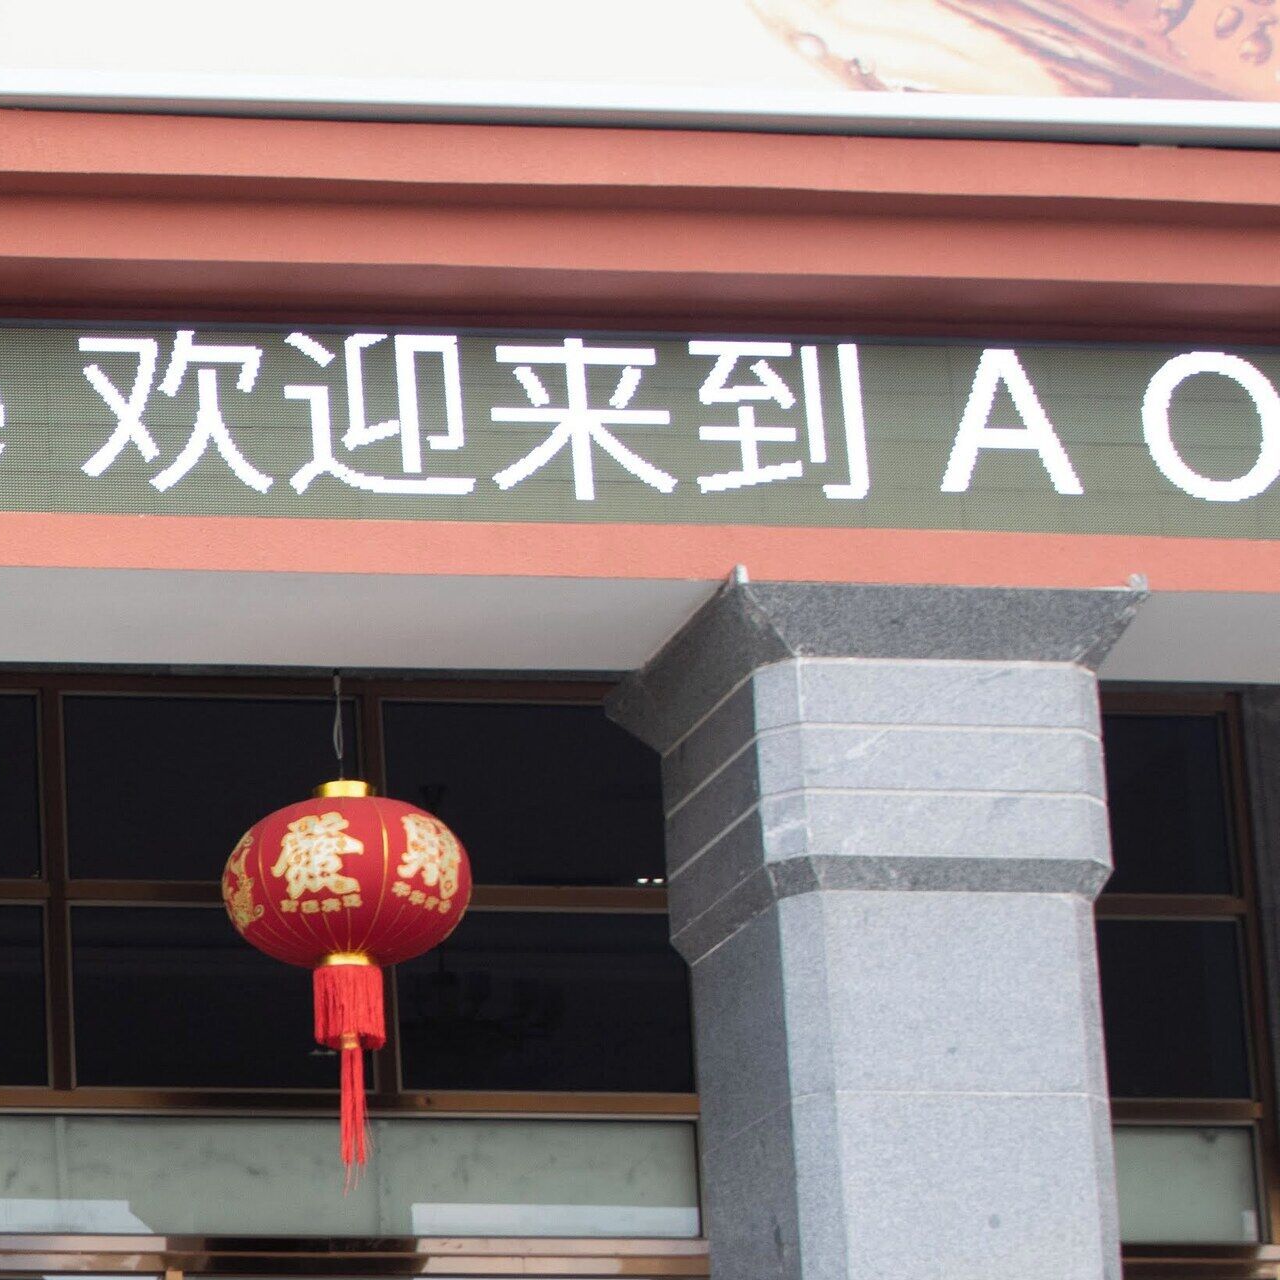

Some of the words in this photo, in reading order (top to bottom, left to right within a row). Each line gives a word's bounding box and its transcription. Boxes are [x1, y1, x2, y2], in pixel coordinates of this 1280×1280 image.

[78, 331, 870, 501] 欢迎来到
[940, 349, 1084, 495] A
